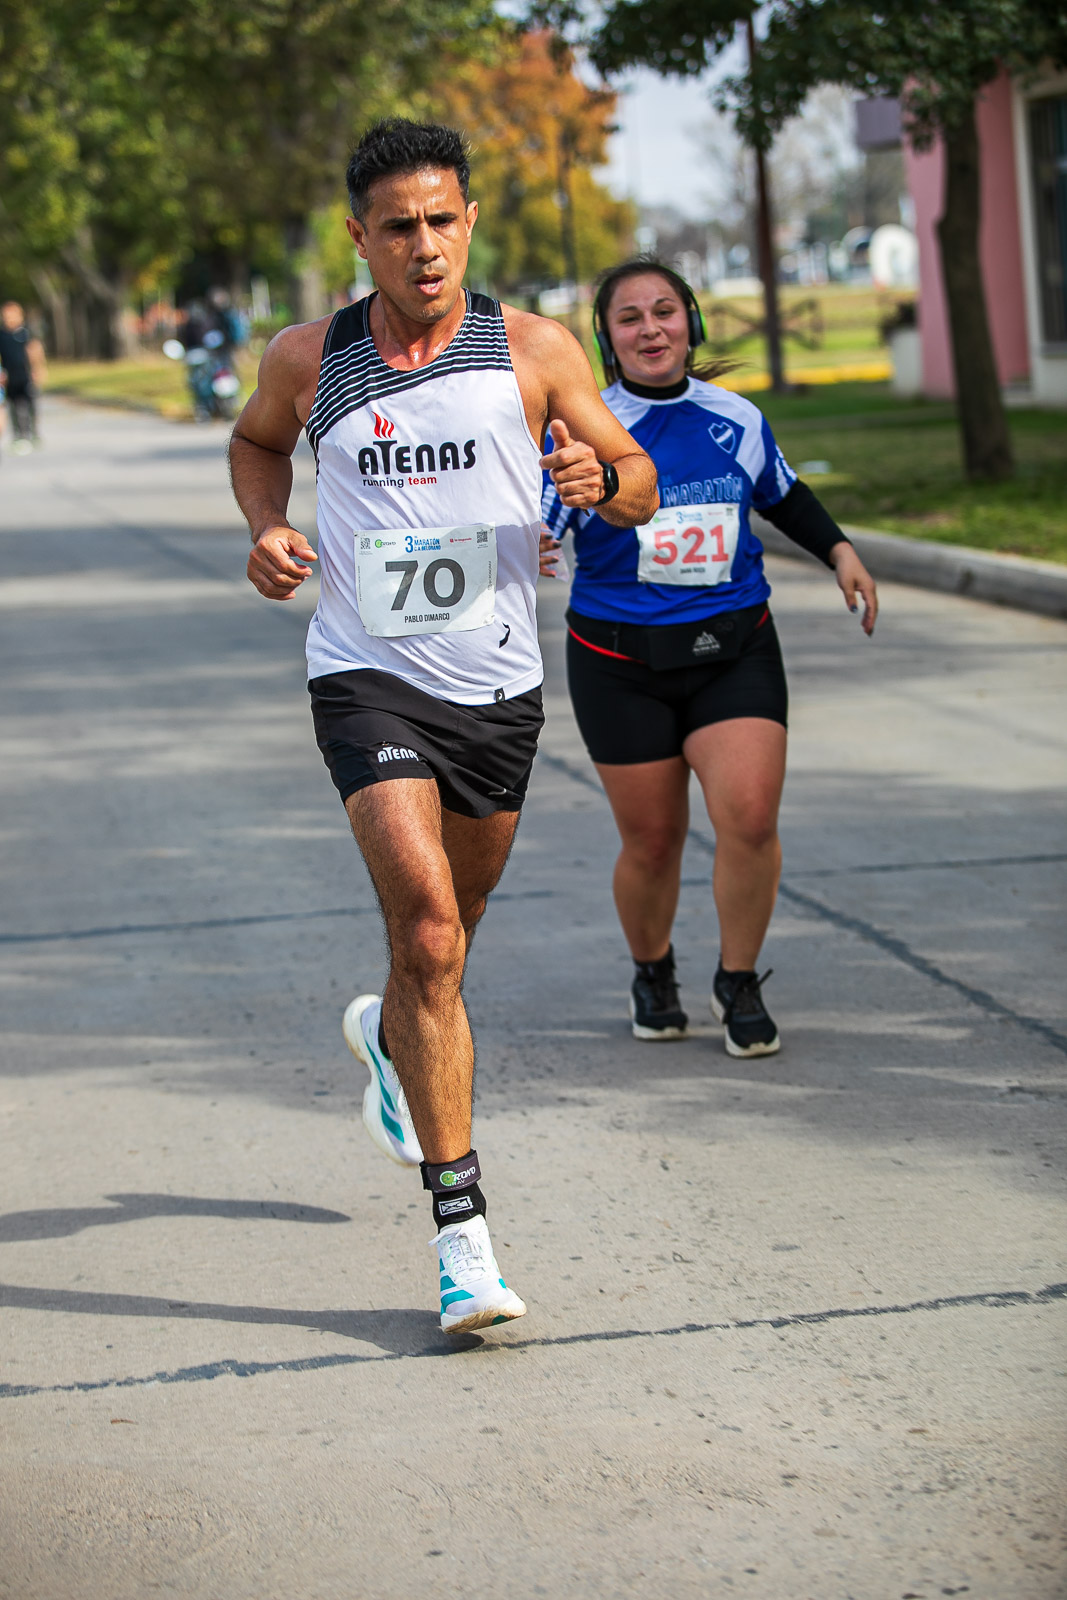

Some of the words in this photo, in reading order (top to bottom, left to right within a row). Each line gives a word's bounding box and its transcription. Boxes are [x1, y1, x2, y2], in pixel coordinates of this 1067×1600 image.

[358, 439, 476, 475] ATENAS
[363, 477, 404, 488] running
[408, 476, 437, 485] team
[405, 535, 414, 553] 3
[414, 537, 440, 546] MARATÓN
[652, 524, 730, 566] 521
[385, 558, 465, 611] 70
[404, 614, 424, 623] PABLO
[424, 612, 450, 622] DIMARCO
[377, 746, 419, 763] ATENA
